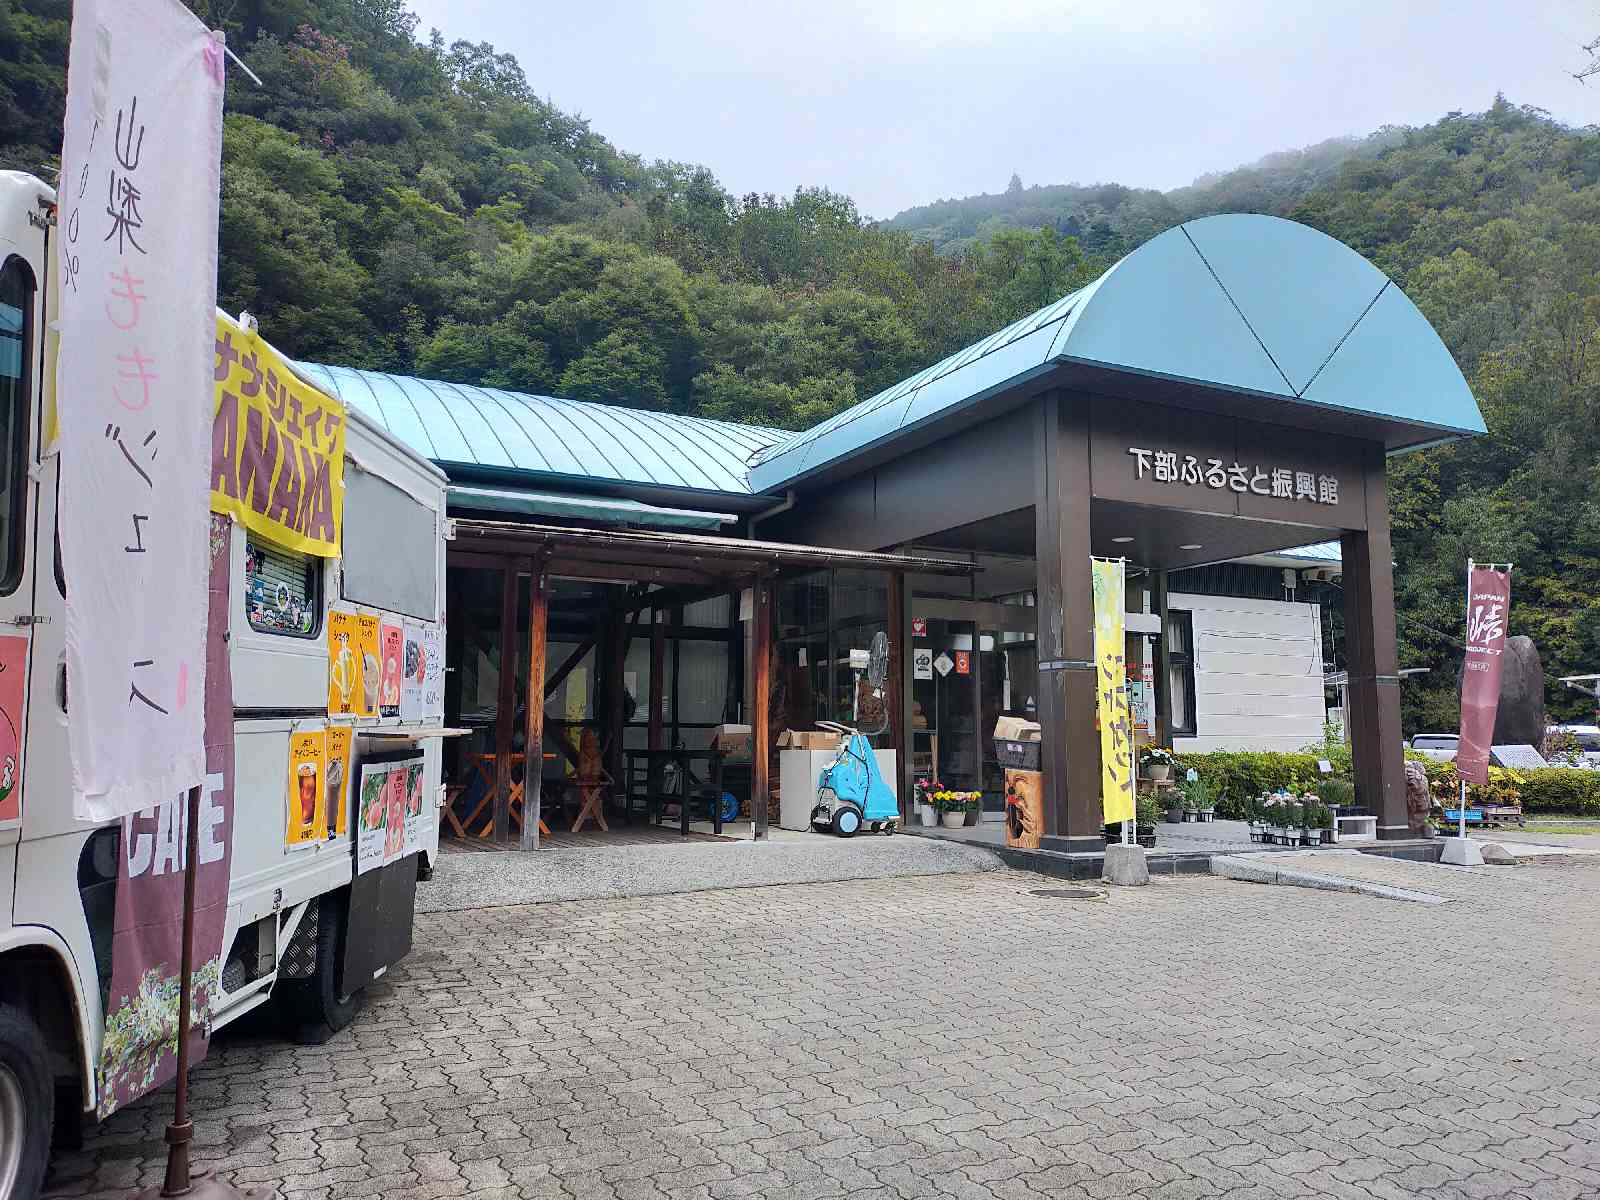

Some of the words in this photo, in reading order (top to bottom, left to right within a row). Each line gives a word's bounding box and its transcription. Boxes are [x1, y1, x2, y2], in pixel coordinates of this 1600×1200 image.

[1129, 447, 1339, 505] 下部ふるさと振興館
[1472, 593, 1505, 602] JAPAN
[1469, 602, 1504, 645] 峠
